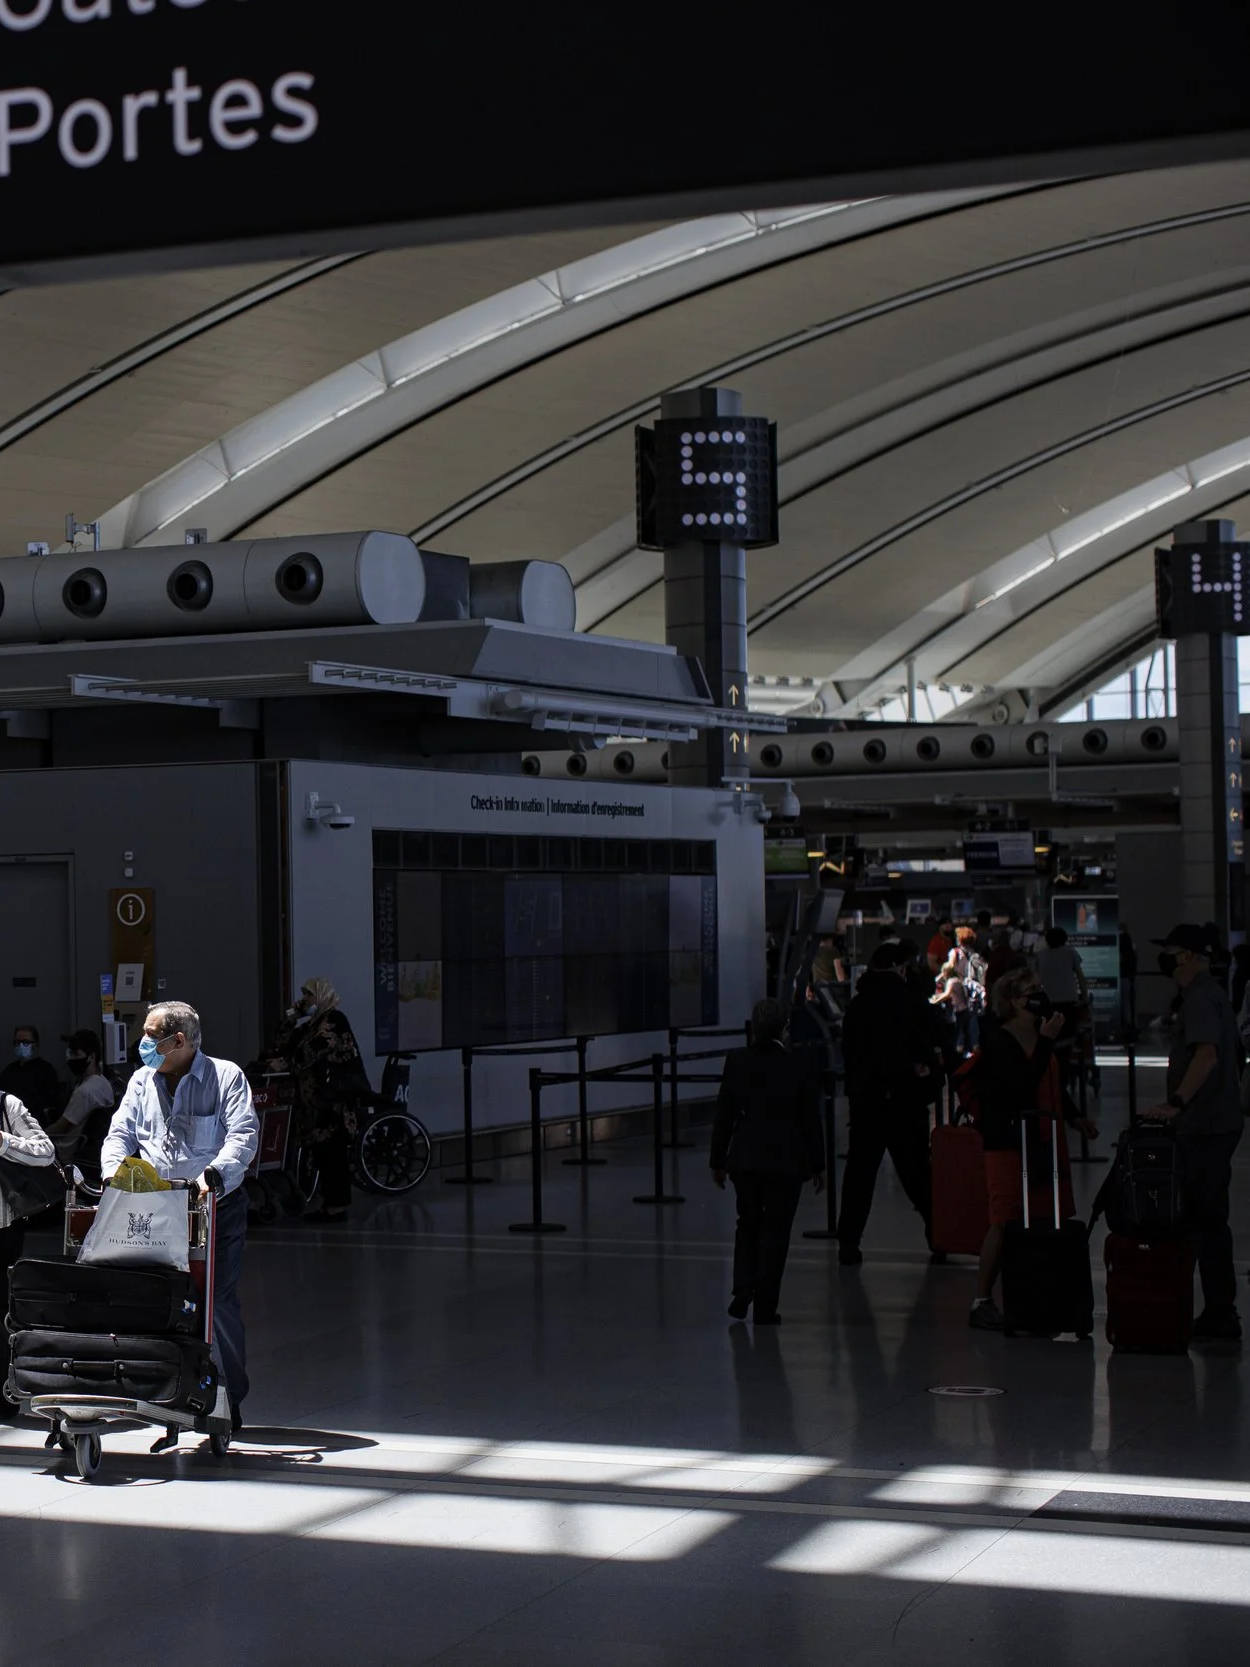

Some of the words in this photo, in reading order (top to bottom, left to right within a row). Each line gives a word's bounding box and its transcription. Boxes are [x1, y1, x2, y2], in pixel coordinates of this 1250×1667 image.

[680, 429, 747, 527] 5
[1190, 551, 1245, 623] 4
[470, 795, 503, 811] Check-in
[504, 797, 546, 813] Information
[551, 799, 590, 815] Information
[591, 801, 645, 819] d'enregistrement
[109, 1238, 150, 1246] HUDSON'S
